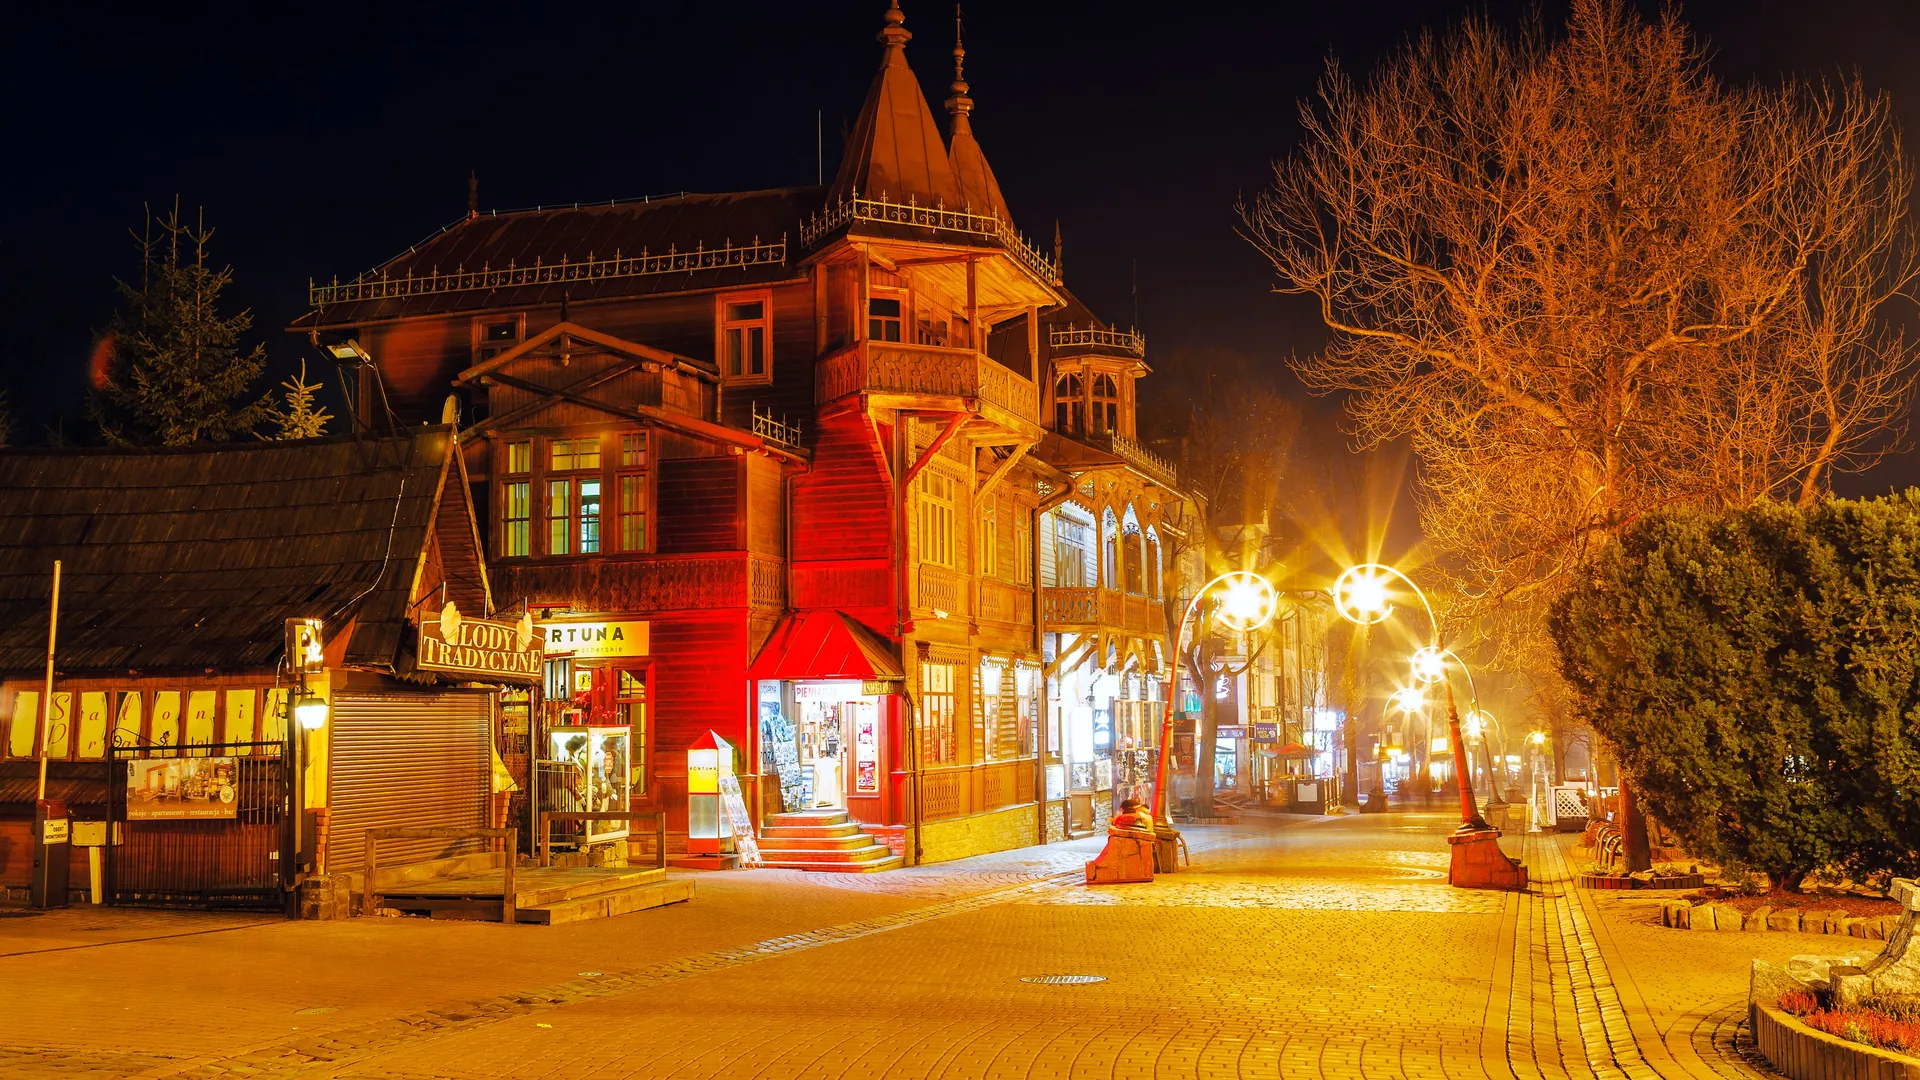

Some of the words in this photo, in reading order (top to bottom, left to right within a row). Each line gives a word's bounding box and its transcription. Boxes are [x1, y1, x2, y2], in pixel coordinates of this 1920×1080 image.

[459, 624, 515, 651] LODY
[551, 626, 625, 643] RTUNA
[423, 635, 541, 673] TRADYCYJNE
[129, 809, 147, 818] pokoje
[151, 810, 185, 818] apartamenty
[190, 809, 220, 817] restauracja
